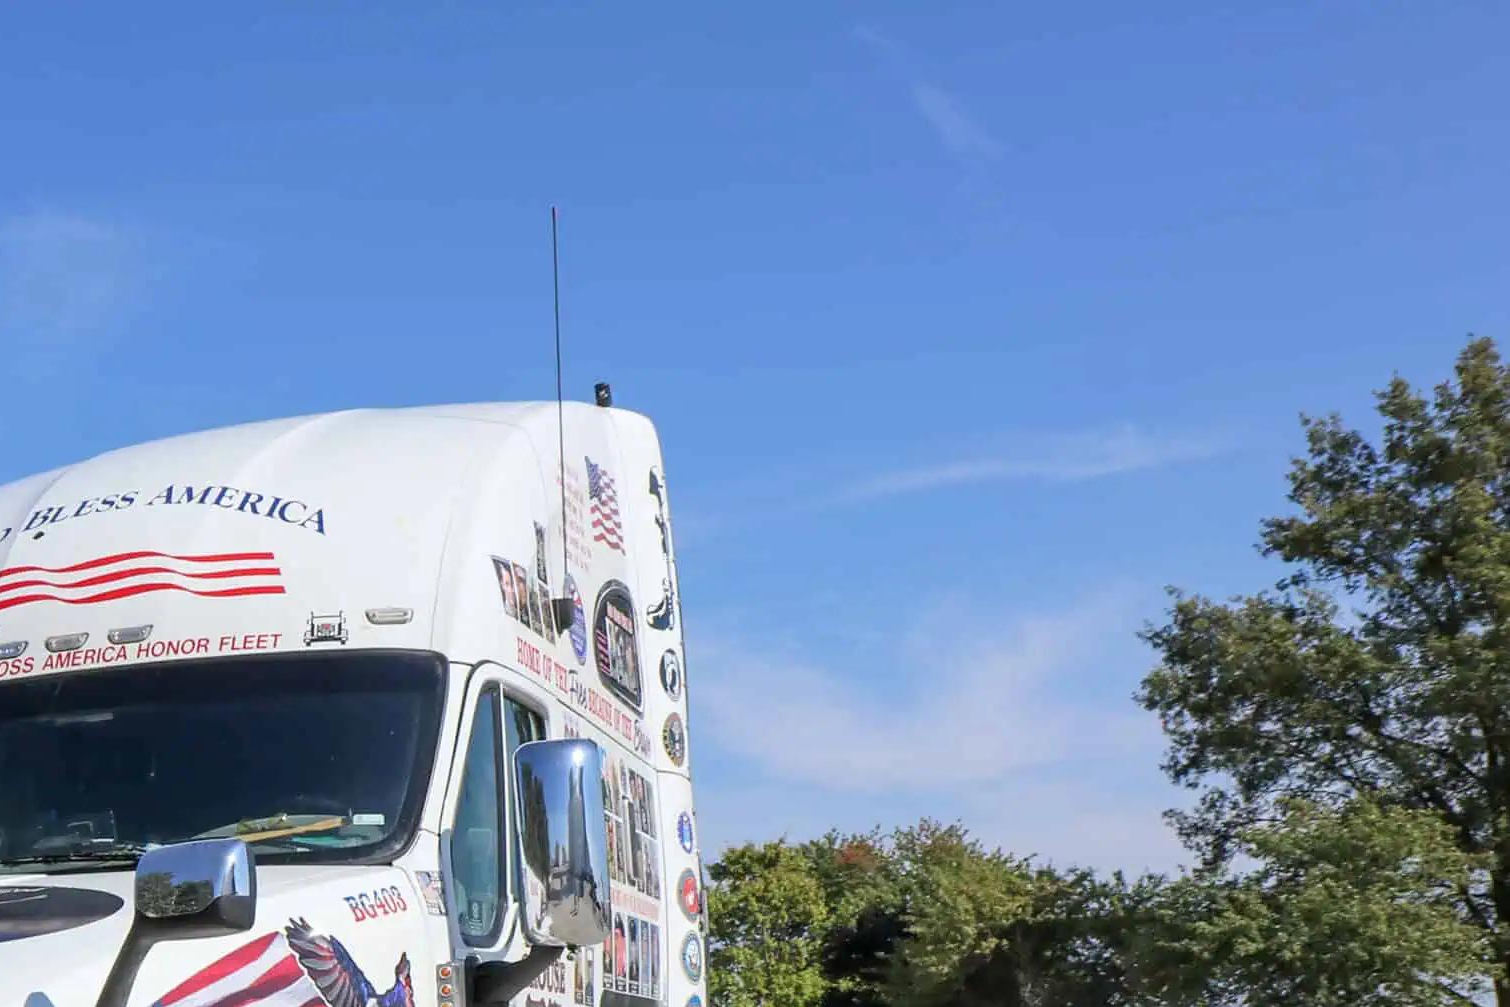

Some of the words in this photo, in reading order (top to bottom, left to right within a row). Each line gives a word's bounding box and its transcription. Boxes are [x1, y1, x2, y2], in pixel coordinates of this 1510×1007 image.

[21, 491, 139, 533] BLESS
[145, 483, 327, 536] AMERICA
[42, 644, 127, 671] AMERICA
[136, 637, 210, 659] HONOR
[218, 633, 283, 651] FLEET
